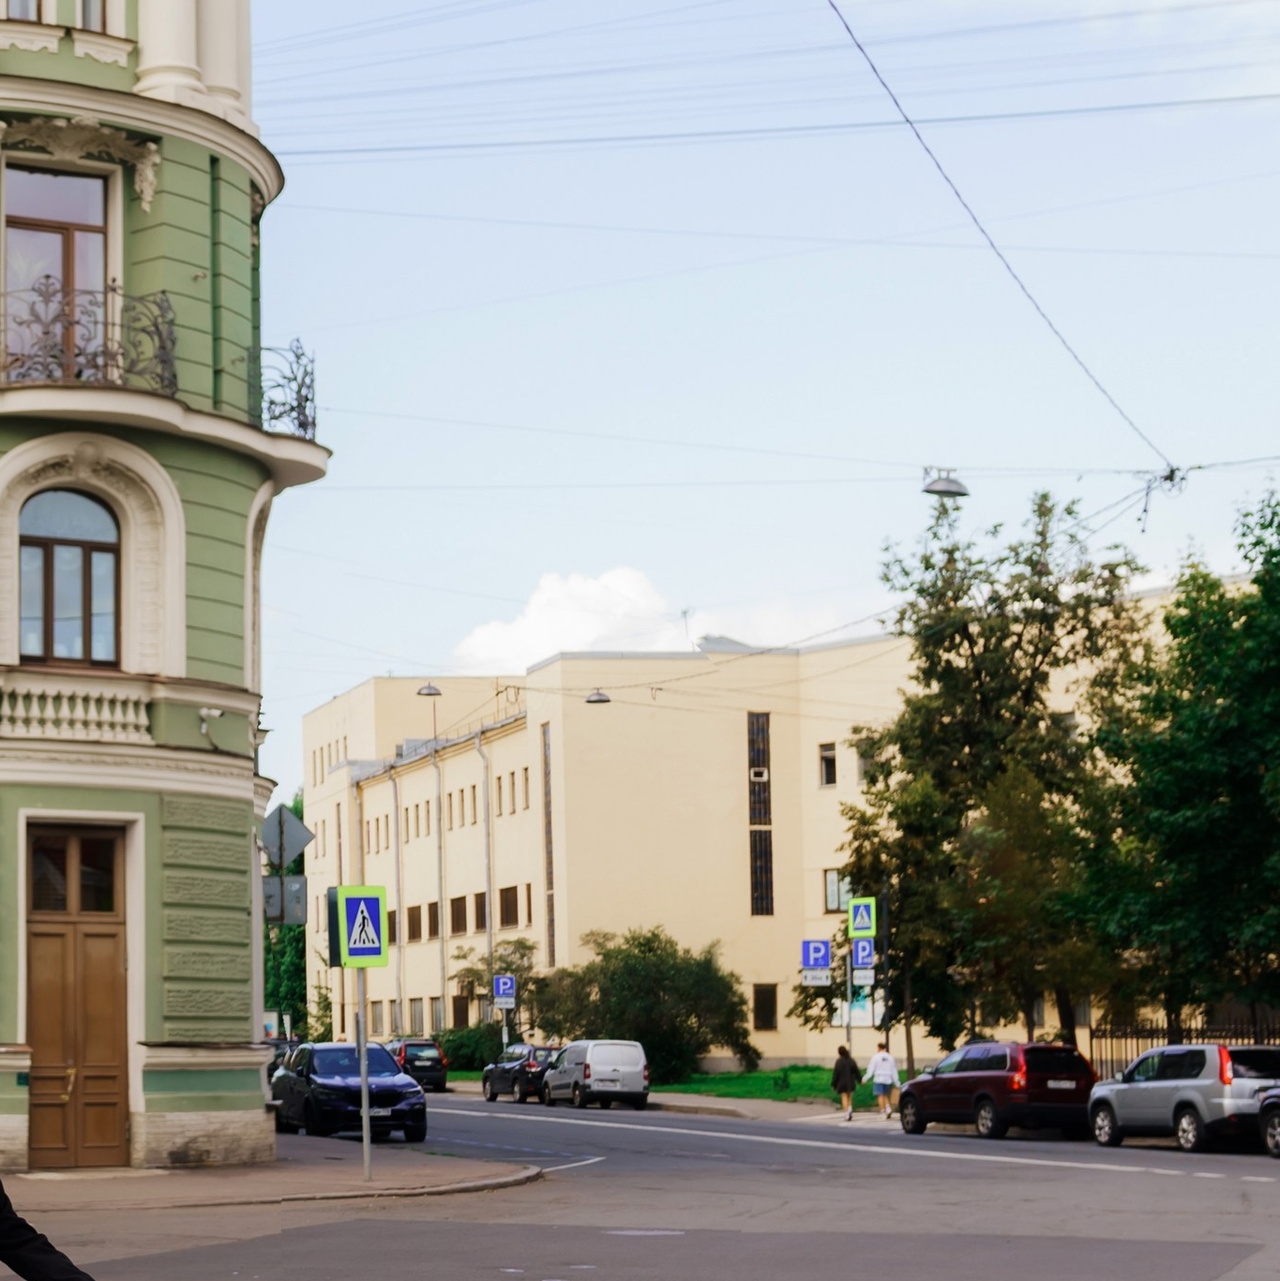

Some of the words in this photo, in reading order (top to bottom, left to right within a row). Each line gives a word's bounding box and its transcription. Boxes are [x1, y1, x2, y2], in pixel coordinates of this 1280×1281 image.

[809, 941, 826, 966] P
[858, 940, 870, 964] P
[499, 977, 512, 995] P
